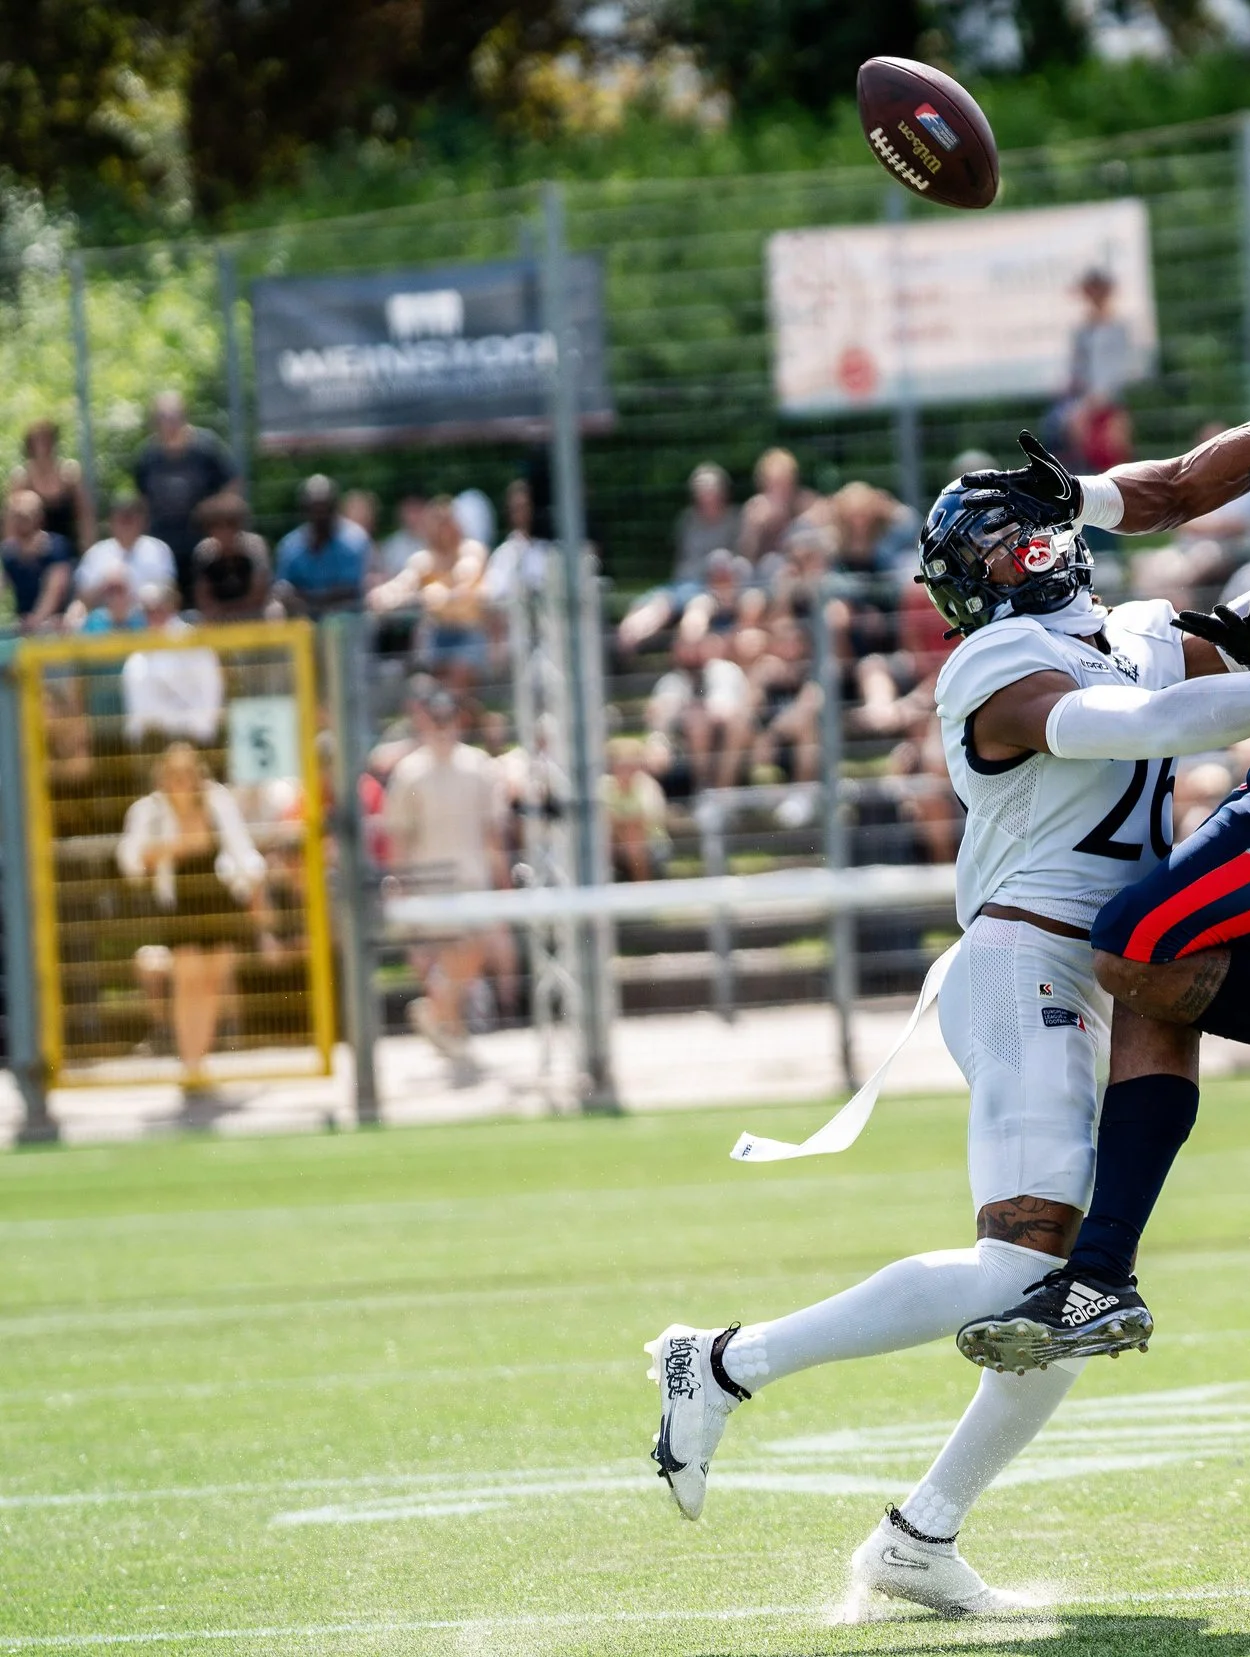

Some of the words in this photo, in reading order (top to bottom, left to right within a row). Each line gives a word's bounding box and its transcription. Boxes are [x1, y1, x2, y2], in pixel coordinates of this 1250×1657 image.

[897, 120, 942, 175] Wilson
[248, 724, 277, 770] 5
[1072, 757, 1176, 862] 26
[1061, 1295, 1120, 1327] adidas
